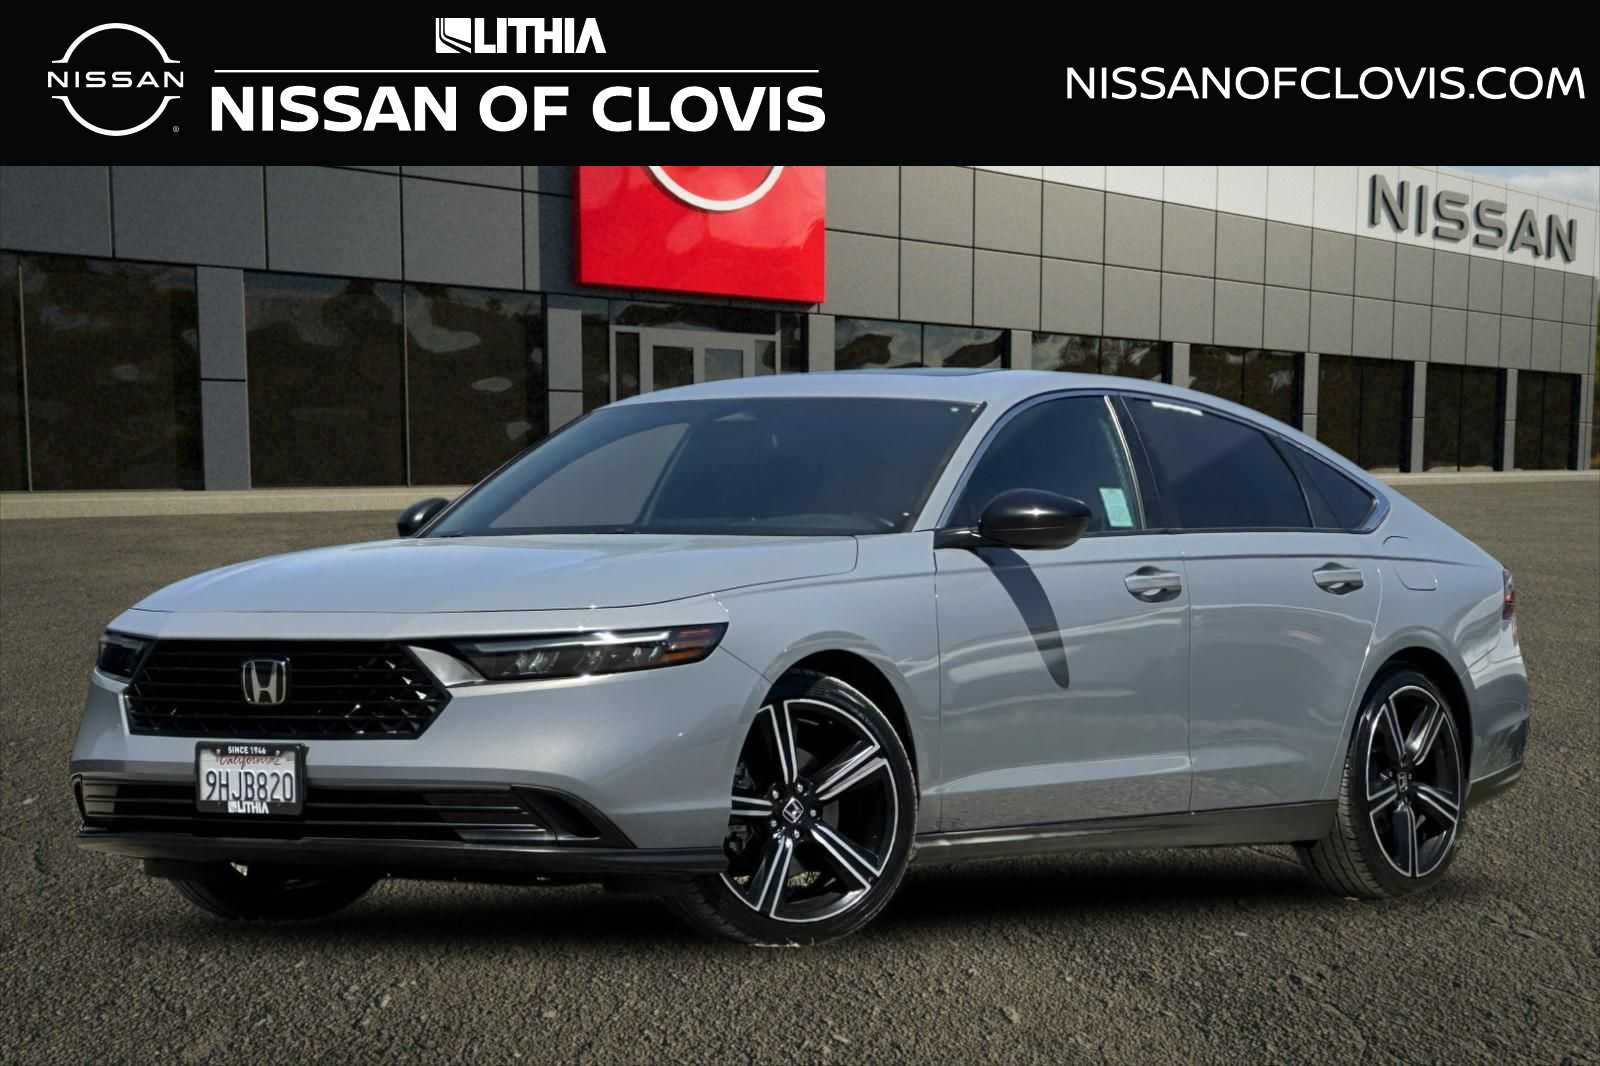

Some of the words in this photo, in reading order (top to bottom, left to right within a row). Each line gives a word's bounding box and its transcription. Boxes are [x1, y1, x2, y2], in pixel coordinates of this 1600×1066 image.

[1368, 173, 1578, 263] NISSAN
[228, 746, 249, 754] SINCE
[206, 771, 294, 802] 9HJB820
